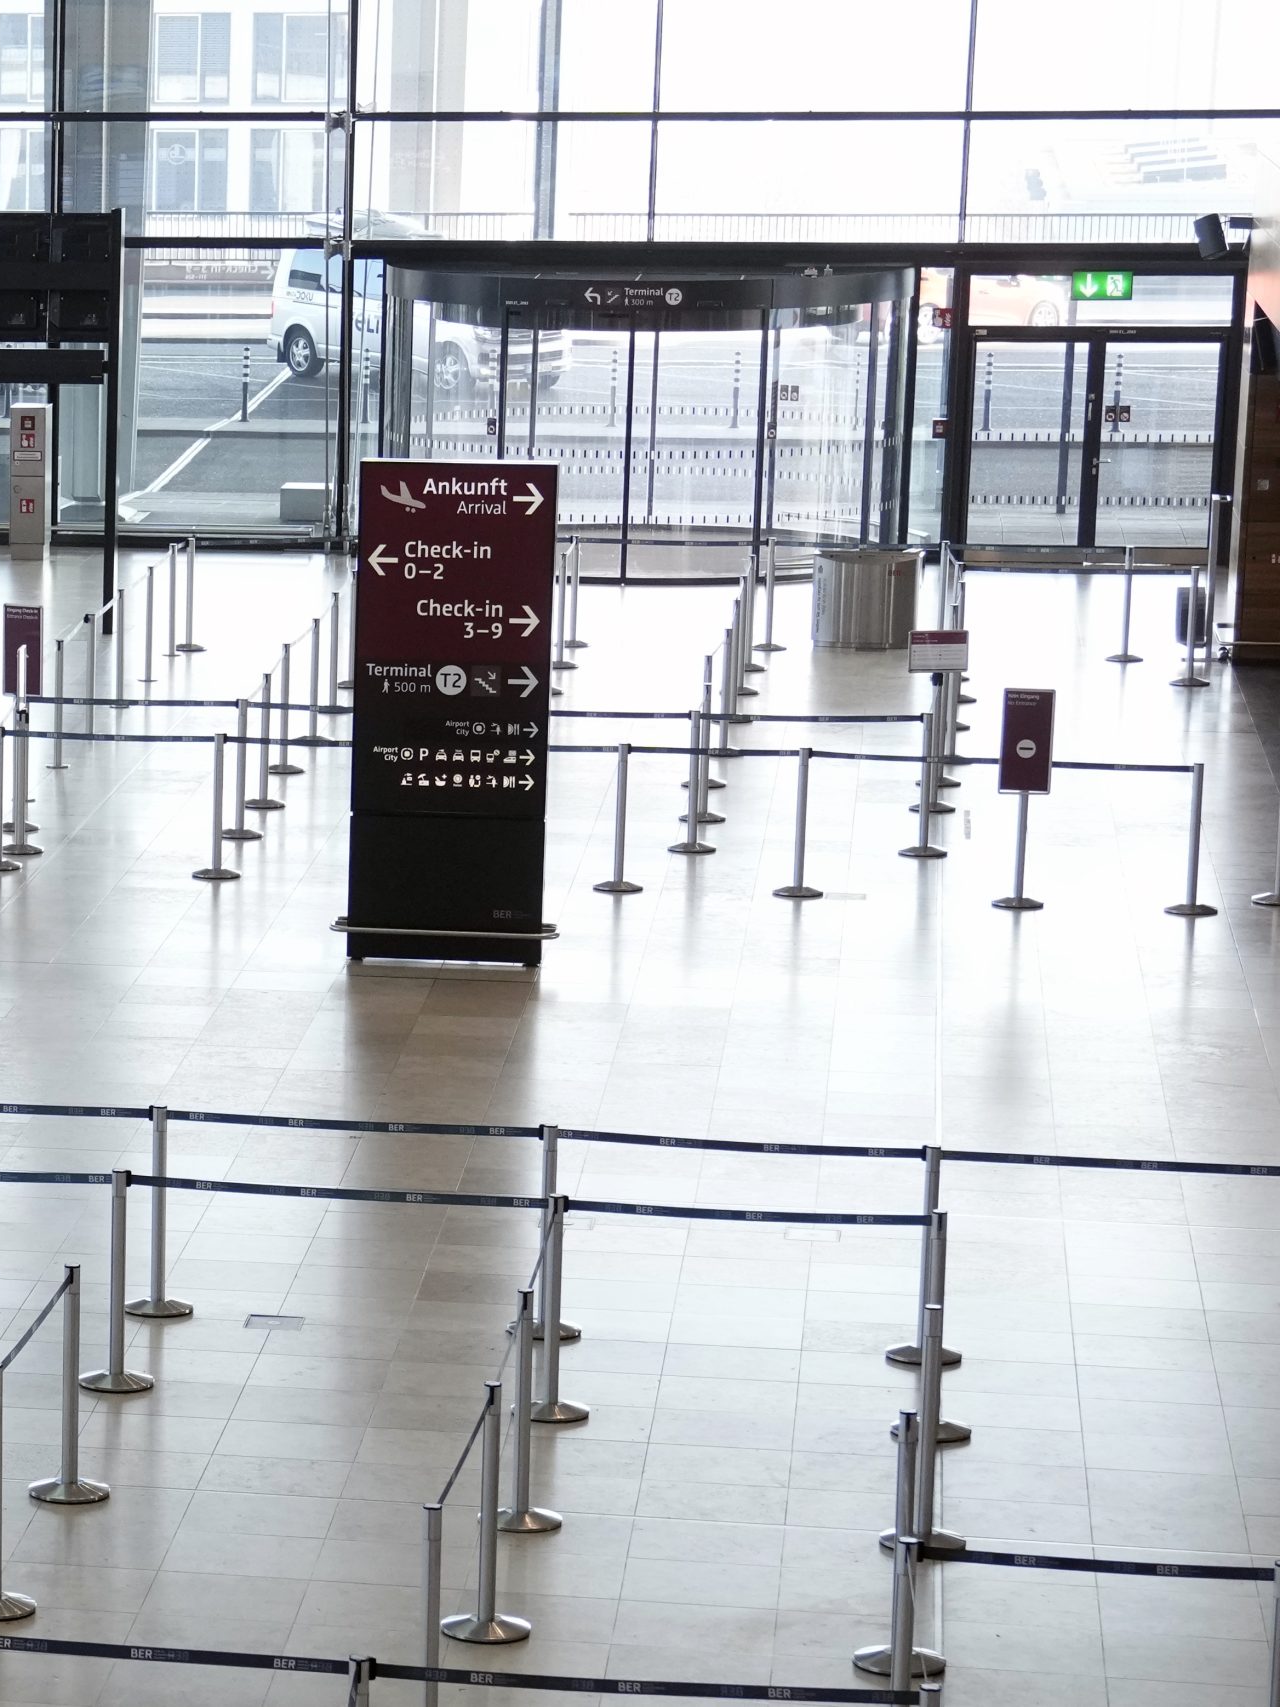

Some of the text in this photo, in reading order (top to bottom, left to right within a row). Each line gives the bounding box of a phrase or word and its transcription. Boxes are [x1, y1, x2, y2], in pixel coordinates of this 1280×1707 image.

[624, 288, 663, 296] Terminal
[668, 292, 680, 302] T2
[422, 477, 508, 496] Ankunft
[456, 501, 507, 515] Arrival
[404, 540, 492, 559] Check-in
[416, 599, 503, 618] Check-in
[366, 663, 432, 678] Terminal
[439, 673, 462, 688] T2
[394, 682, 431, 693] 500 m
[445, 720, 470, 729] Airport
[456, 728, 470, 736] City
[373, 745, 398, 755] Airport
[384, 754, 398, 763] City
[492, 910, 512, 919] BER
[288, 1119, 304, 1127] BER
[489, 1127, 505, 1135] BER
[660, 1138, 675, 1146] BER
[763, 1144, 780, 1152] BER
[868, 1148, 885, 1156] BER
[88, 1175, 105, 1183] BER
[196, 1181, 212, 1189] BER
[300, 1188, 316, 1196] BER
[406, 1194, 422, 1202] BER
[513, 1199, 529, 1207] BER
[636, 1206, 653, 1214] BER
[746, 1212, 762, 1220] BER
[130, 1647, 152, 1659] BER
[273, 1658, 296, 1670] BER
[470, 1672, 493, 1685] BER
[618, 1681, 641, 1694] BER
[768, 1687, 792, 1699] BER
